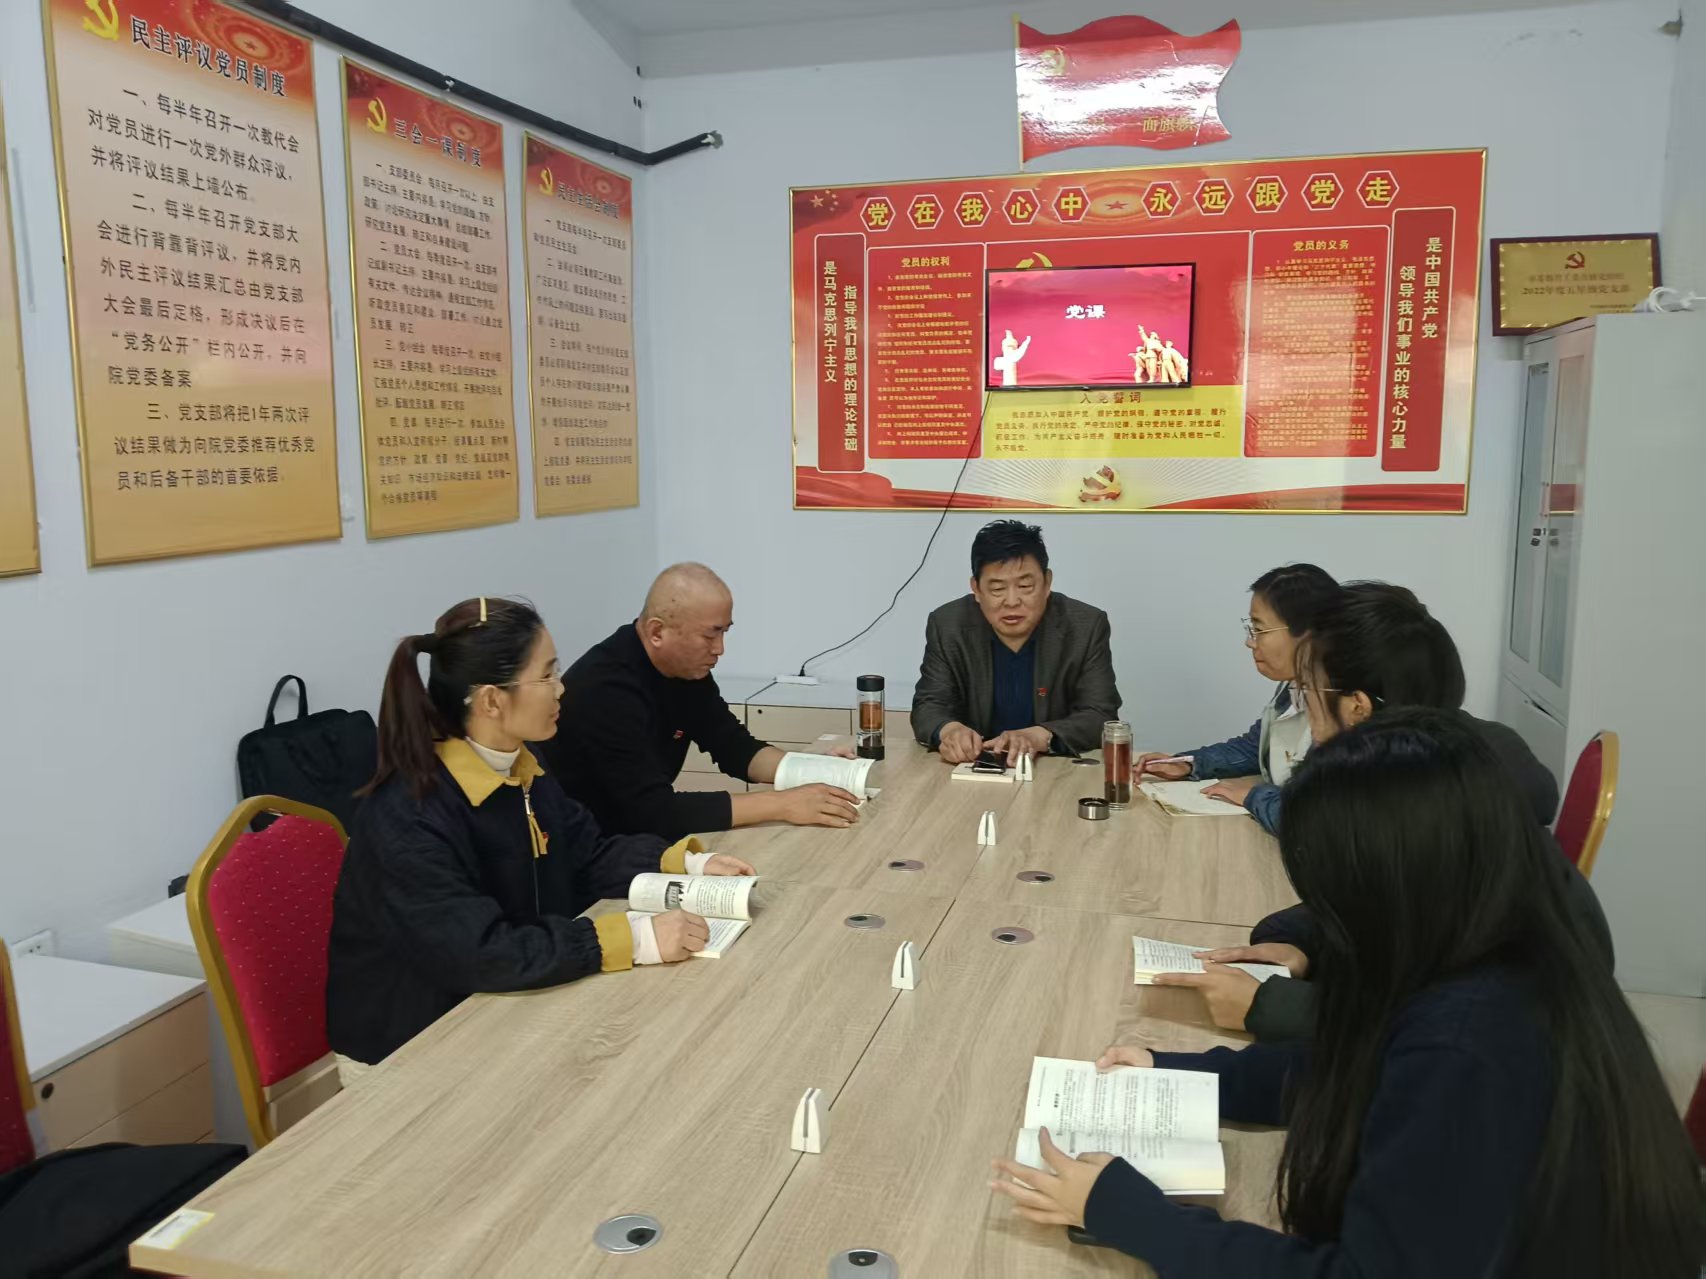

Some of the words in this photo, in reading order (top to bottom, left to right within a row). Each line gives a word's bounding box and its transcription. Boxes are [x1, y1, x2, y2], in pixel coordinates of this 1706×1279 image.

[131, 15, 287, 97] 民主评议党员制度
[123, 89, 299, 154] 一、每半年召开一次教代会
[132, 193, 298, 243] 二、每半年召开党支部大
[867, 192, 1083, 226] 党在我心中
[1150, 177, 1391, 213] 永远跟党走
[901, 256, 950, 268] 党员的权利
[1293, 240, 1349, 252] 党员的义务
[101, 257, 304, 304] 外民主评议结果汇总由党支部
[1422, 237, 1442, 339] 是中国共产党
[824, 261, 837, 383] 是马克思列宁主义
[1065, 304, 1106, 319] 党课
[108, 365, 192, 388] 院党委备案
[844, 285, 858, 451] 指导我们思想的理论基础
[1390, 265, 1416, 449] 领导我们事业的核心力量
[147, 402, 310, 424] 三、党支部将把1年两次评
[114, 435, 315, 457] 议结果做为向院党委推荐优秀党
